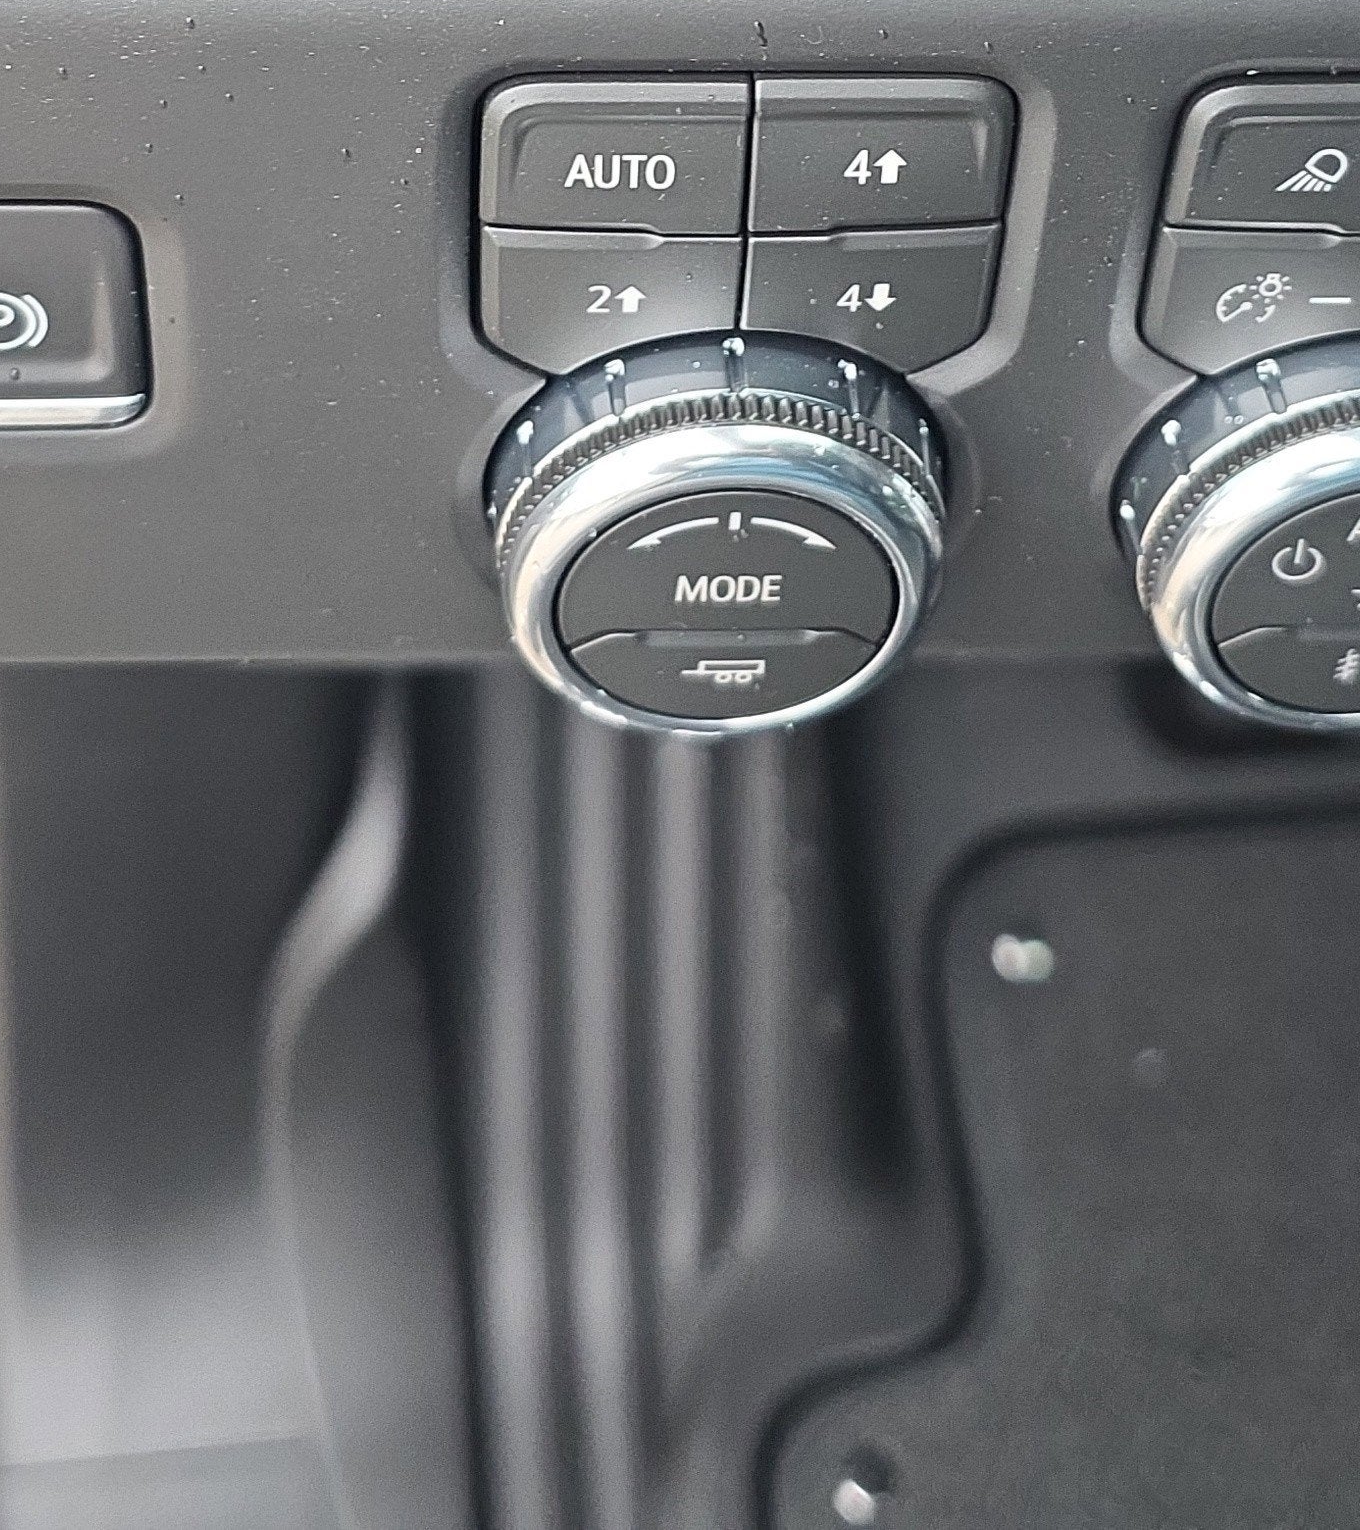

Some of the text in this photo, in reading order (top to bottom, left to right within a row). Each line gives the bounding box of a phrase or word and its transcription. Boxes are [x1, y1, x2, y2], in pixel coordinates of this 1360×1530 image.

[563, 153, 676, 190] AUTO
[844, 150, 873, 185] 4
[586, 286, 611, 313] 2
[836, 285, 863, 312] 4
[674, 574, 783, 603] MODE
